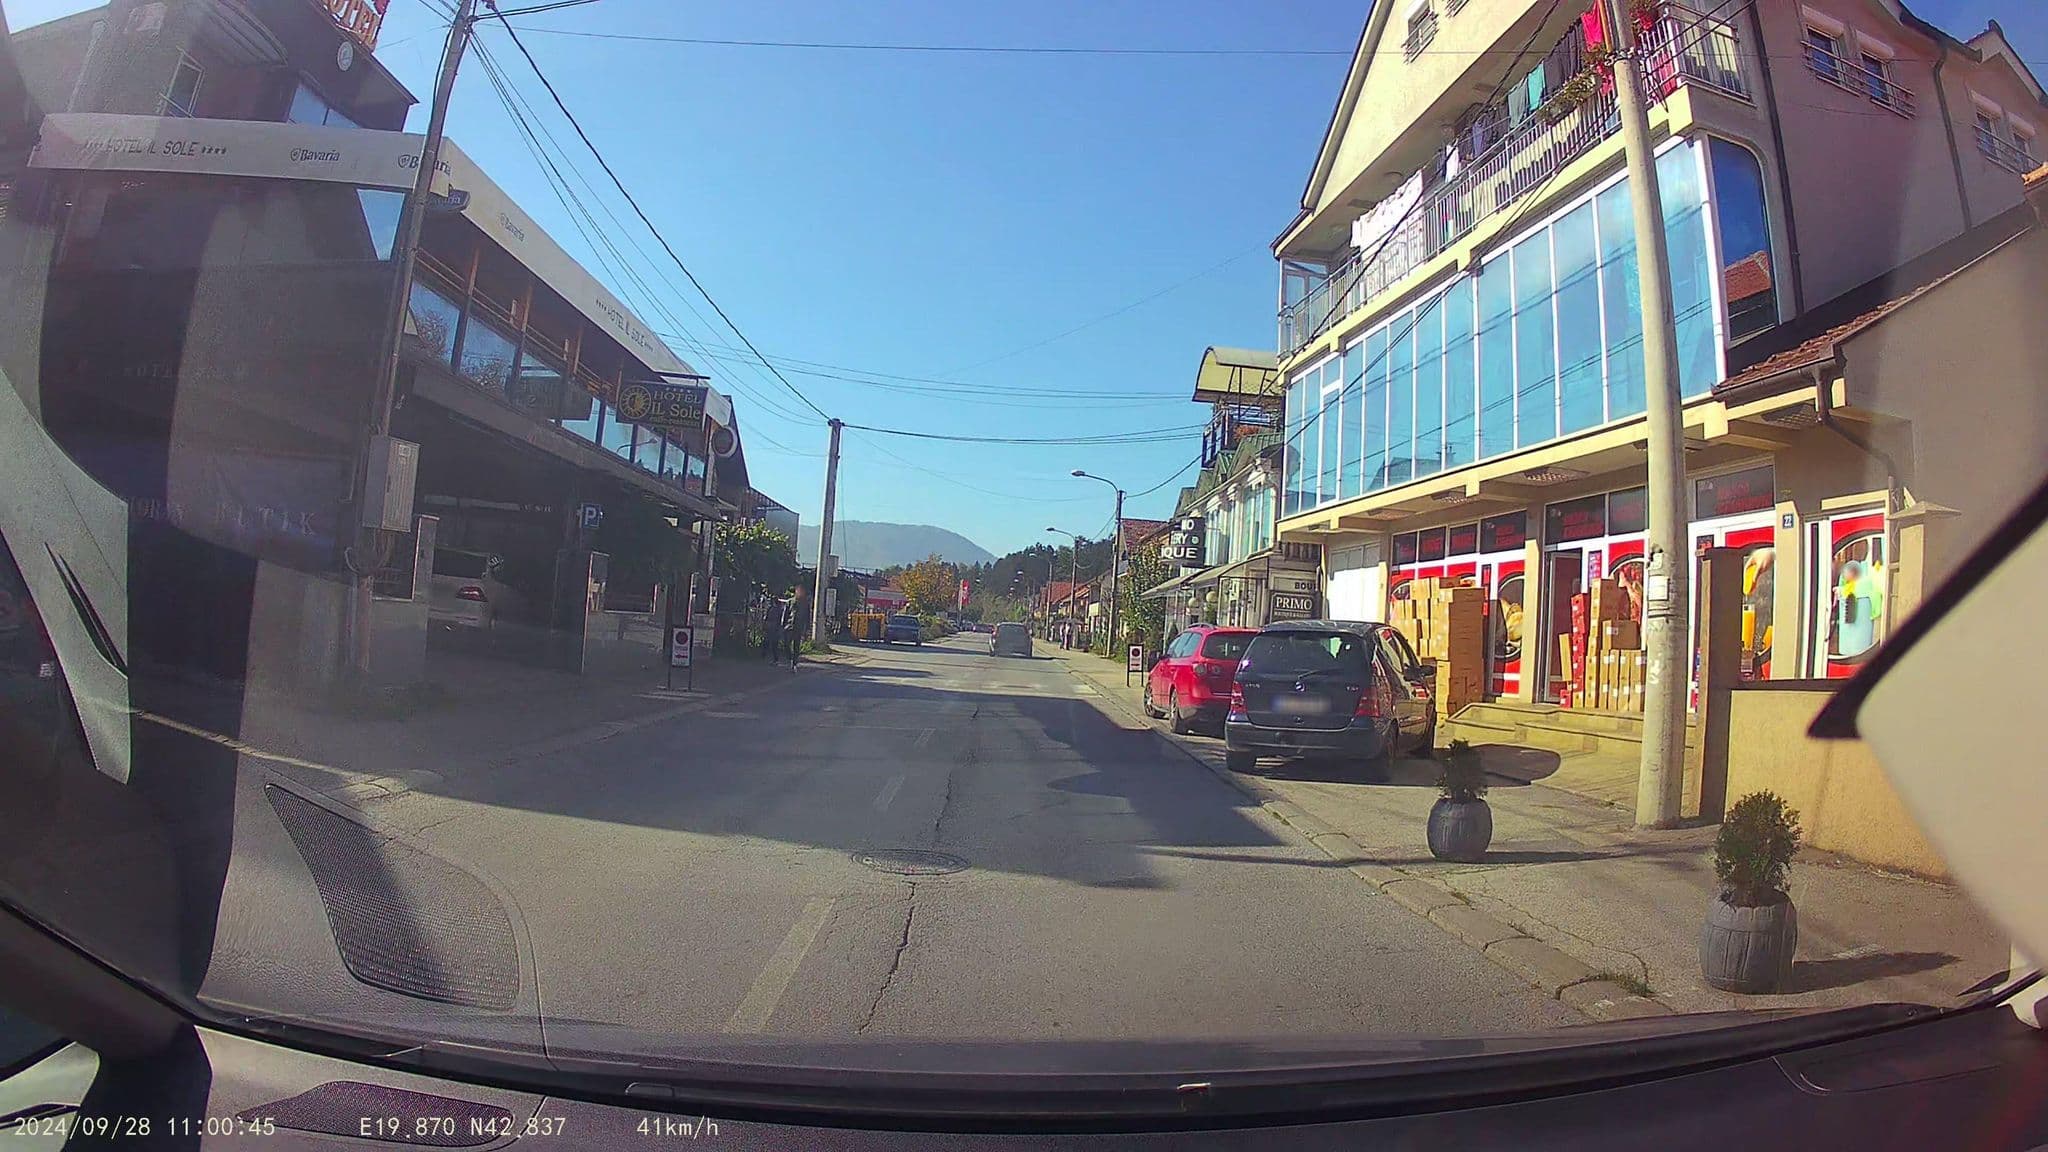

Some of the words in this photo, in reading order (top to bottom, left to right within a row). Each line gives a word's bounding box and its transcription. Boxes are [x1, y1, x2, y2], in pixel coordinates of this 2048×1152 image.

[107, 138, 142, 154] HOTEL
[163, 141, 199, 157] SOLE
[300, 149, 340, 162] Bavaria
[653, 390, 700, 404] HOTEL
[651, 402, 665, 415] IL
[670, 404, 700, 419] Sole
[584, 507, 597, 525] P
[1783, 515, 1792, 527] 22
[1276, 596, 1313, 610] PRIMO
